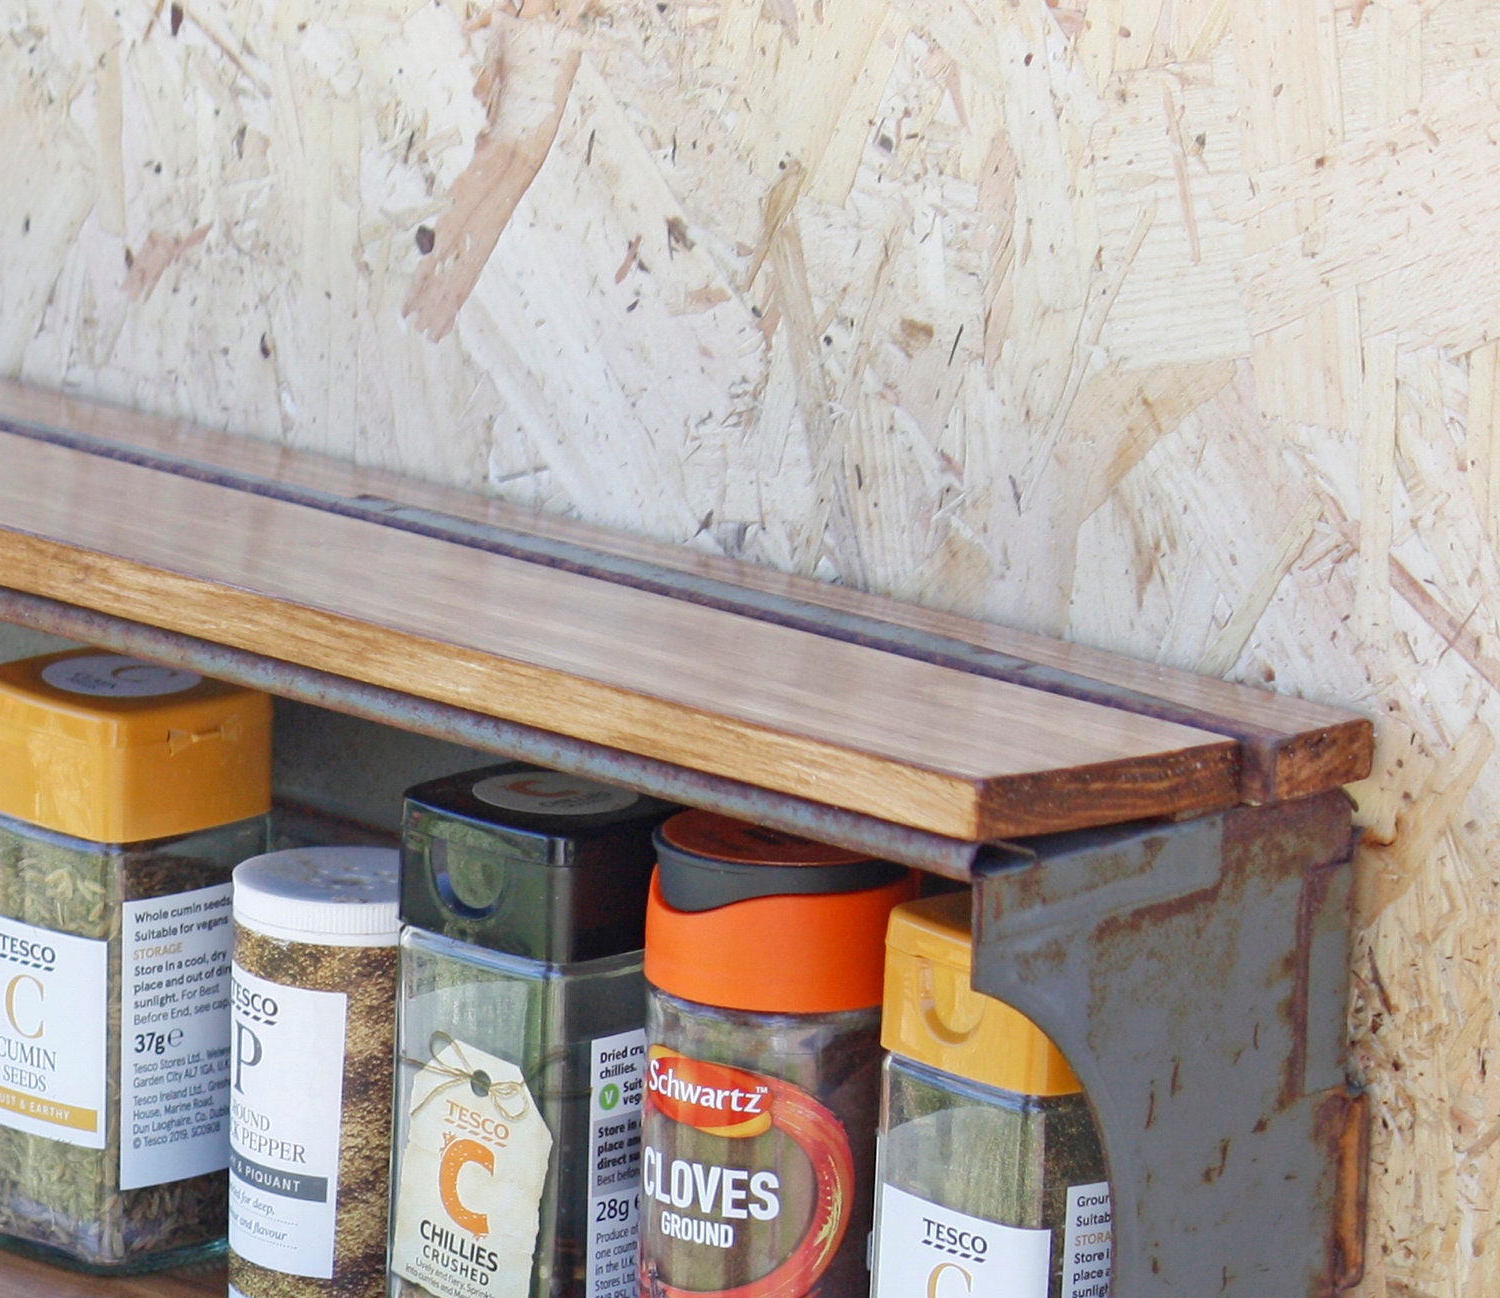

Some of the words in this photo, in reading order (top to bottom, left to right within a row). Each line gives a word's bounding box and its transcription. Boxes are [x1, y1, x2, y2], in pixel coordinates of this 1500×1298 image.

[134, 908, 169, 924] Whole
[171, 902, 202, 917] cumin
[134, 925, 178, 942] Suitable
[180, 922, 194, 934] for
[196, 915, 229, 931] vegans
[133, 942, 183, 961] STORAGE
[134, 964, 163, 977] Store
[165, 960, 175, 971] in
[184, 953, 209, 967] cool,
[211, 949, 227, 962] dry
[134, 979, 163, 996] place
[165, 974, 184, 985] and
[186, 971, 203, 983] out
[205, 966, 215, 979] of
[181, 988, 198, 1001] For
[199, 983, 220, 997] Best
[5, 974, 44, 1039] C
[232, 976, 278, 1017] TESCO
[134, 1011, 168, 1026] Before
[134, 1031, 165, 1055] 37g
[133, 1063, 159, 1075] Tesco
[160, 1056, 186, 1071] Stores
[234, 1019, 263, 1095] P
[600, 1045, 628, 1064] Dried
[3, 1063, 47, 1092] SEEDS
[133, 1074, 165, 1088] Garden
[166, 1071, 182, 1084] City
[19, 1097, 27, 1110] &
[29, 1100, 71, 1121] EARTHY
[446, 1099, 510, 1141] TESCO
[133, 1123, 150, 1135] Dun
[598, 1123, 626, 1138] Store
[627, 1119, 637, 1132] in
[241, 1127, 307, 1164] PEPPER
[597, 1139, 624, 1157] place
[597, 1153, 627, 1170] direct
[245, 1165, 301, 1193] PIQUANT
[439, 1138, 495, 1235] C
[596, 1174, 615, 1187] Best
[643, 1145, 780, 1221] CLOVES
[596, 1198, 629, 1222] 28g
[252, 1220, 288, 1242] flavour
[596, 1227, 629, 1244] Produce
[661, 1210, 735, 1248] GROUND
[922, 1216, 988, 1255] TESCO
[420, 1219, 499, 1273] CHILLIES
[595, 1246, 611, 1260] one
[415, 1256, 436, 1276] Lively
[422, 1244, 490, 1287] CRUSHED
[606, 1260, 619, 1273] the
[1074, 1251, 1105, 1265] Store
[595, 1275, 620, 1292] Stores
[1073, 1268, 1104, 1285] place
